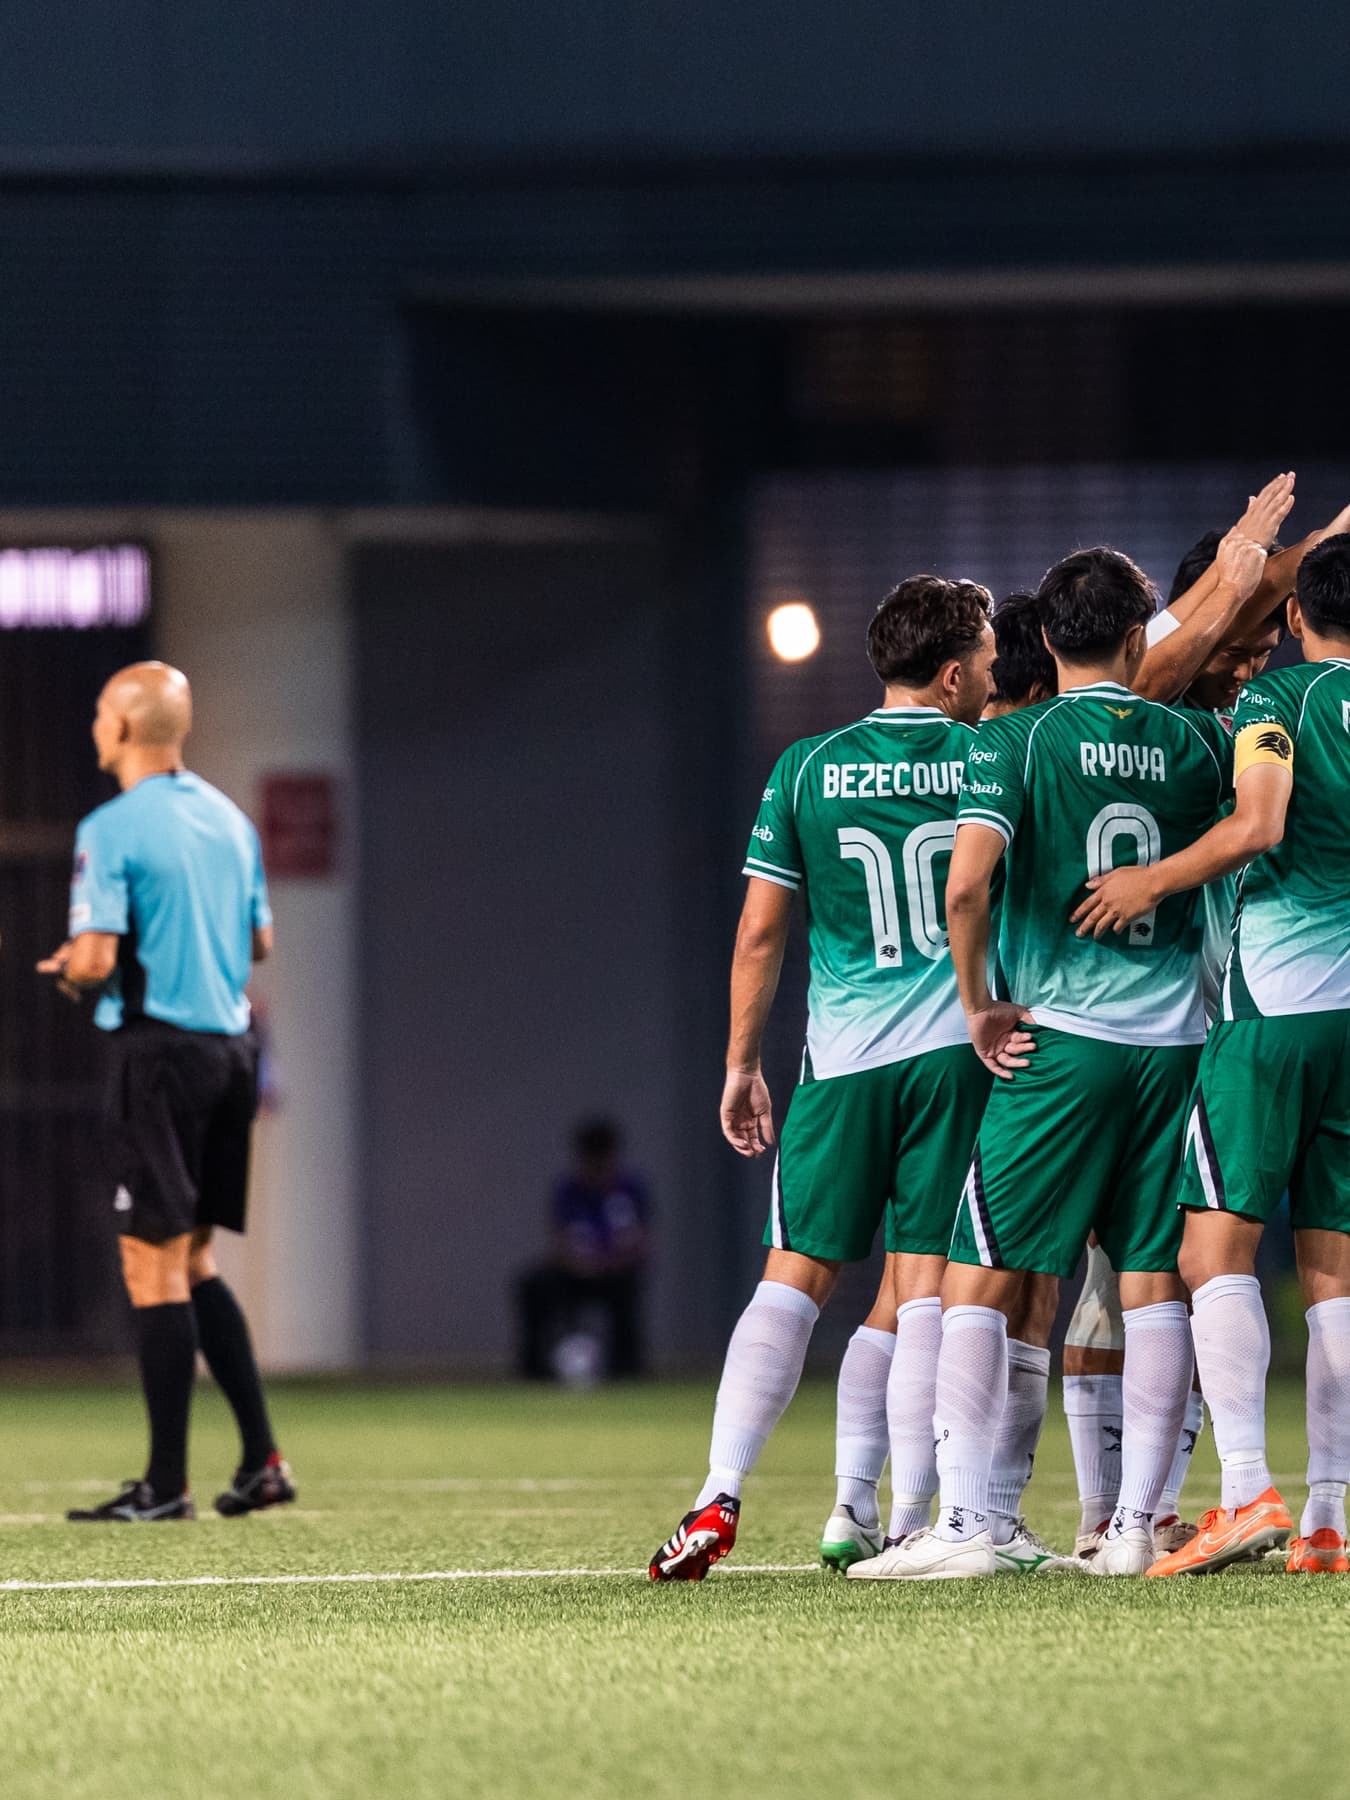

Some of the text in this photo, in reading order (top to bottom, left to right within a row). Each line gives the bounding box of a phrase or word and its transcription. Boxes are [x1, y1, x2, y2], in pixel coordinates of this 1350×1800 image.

[1080, 741, 1166, 782] RYOYA
[837, 819, 959, 969] 10
[943, 1428, 950, 1441] 9
